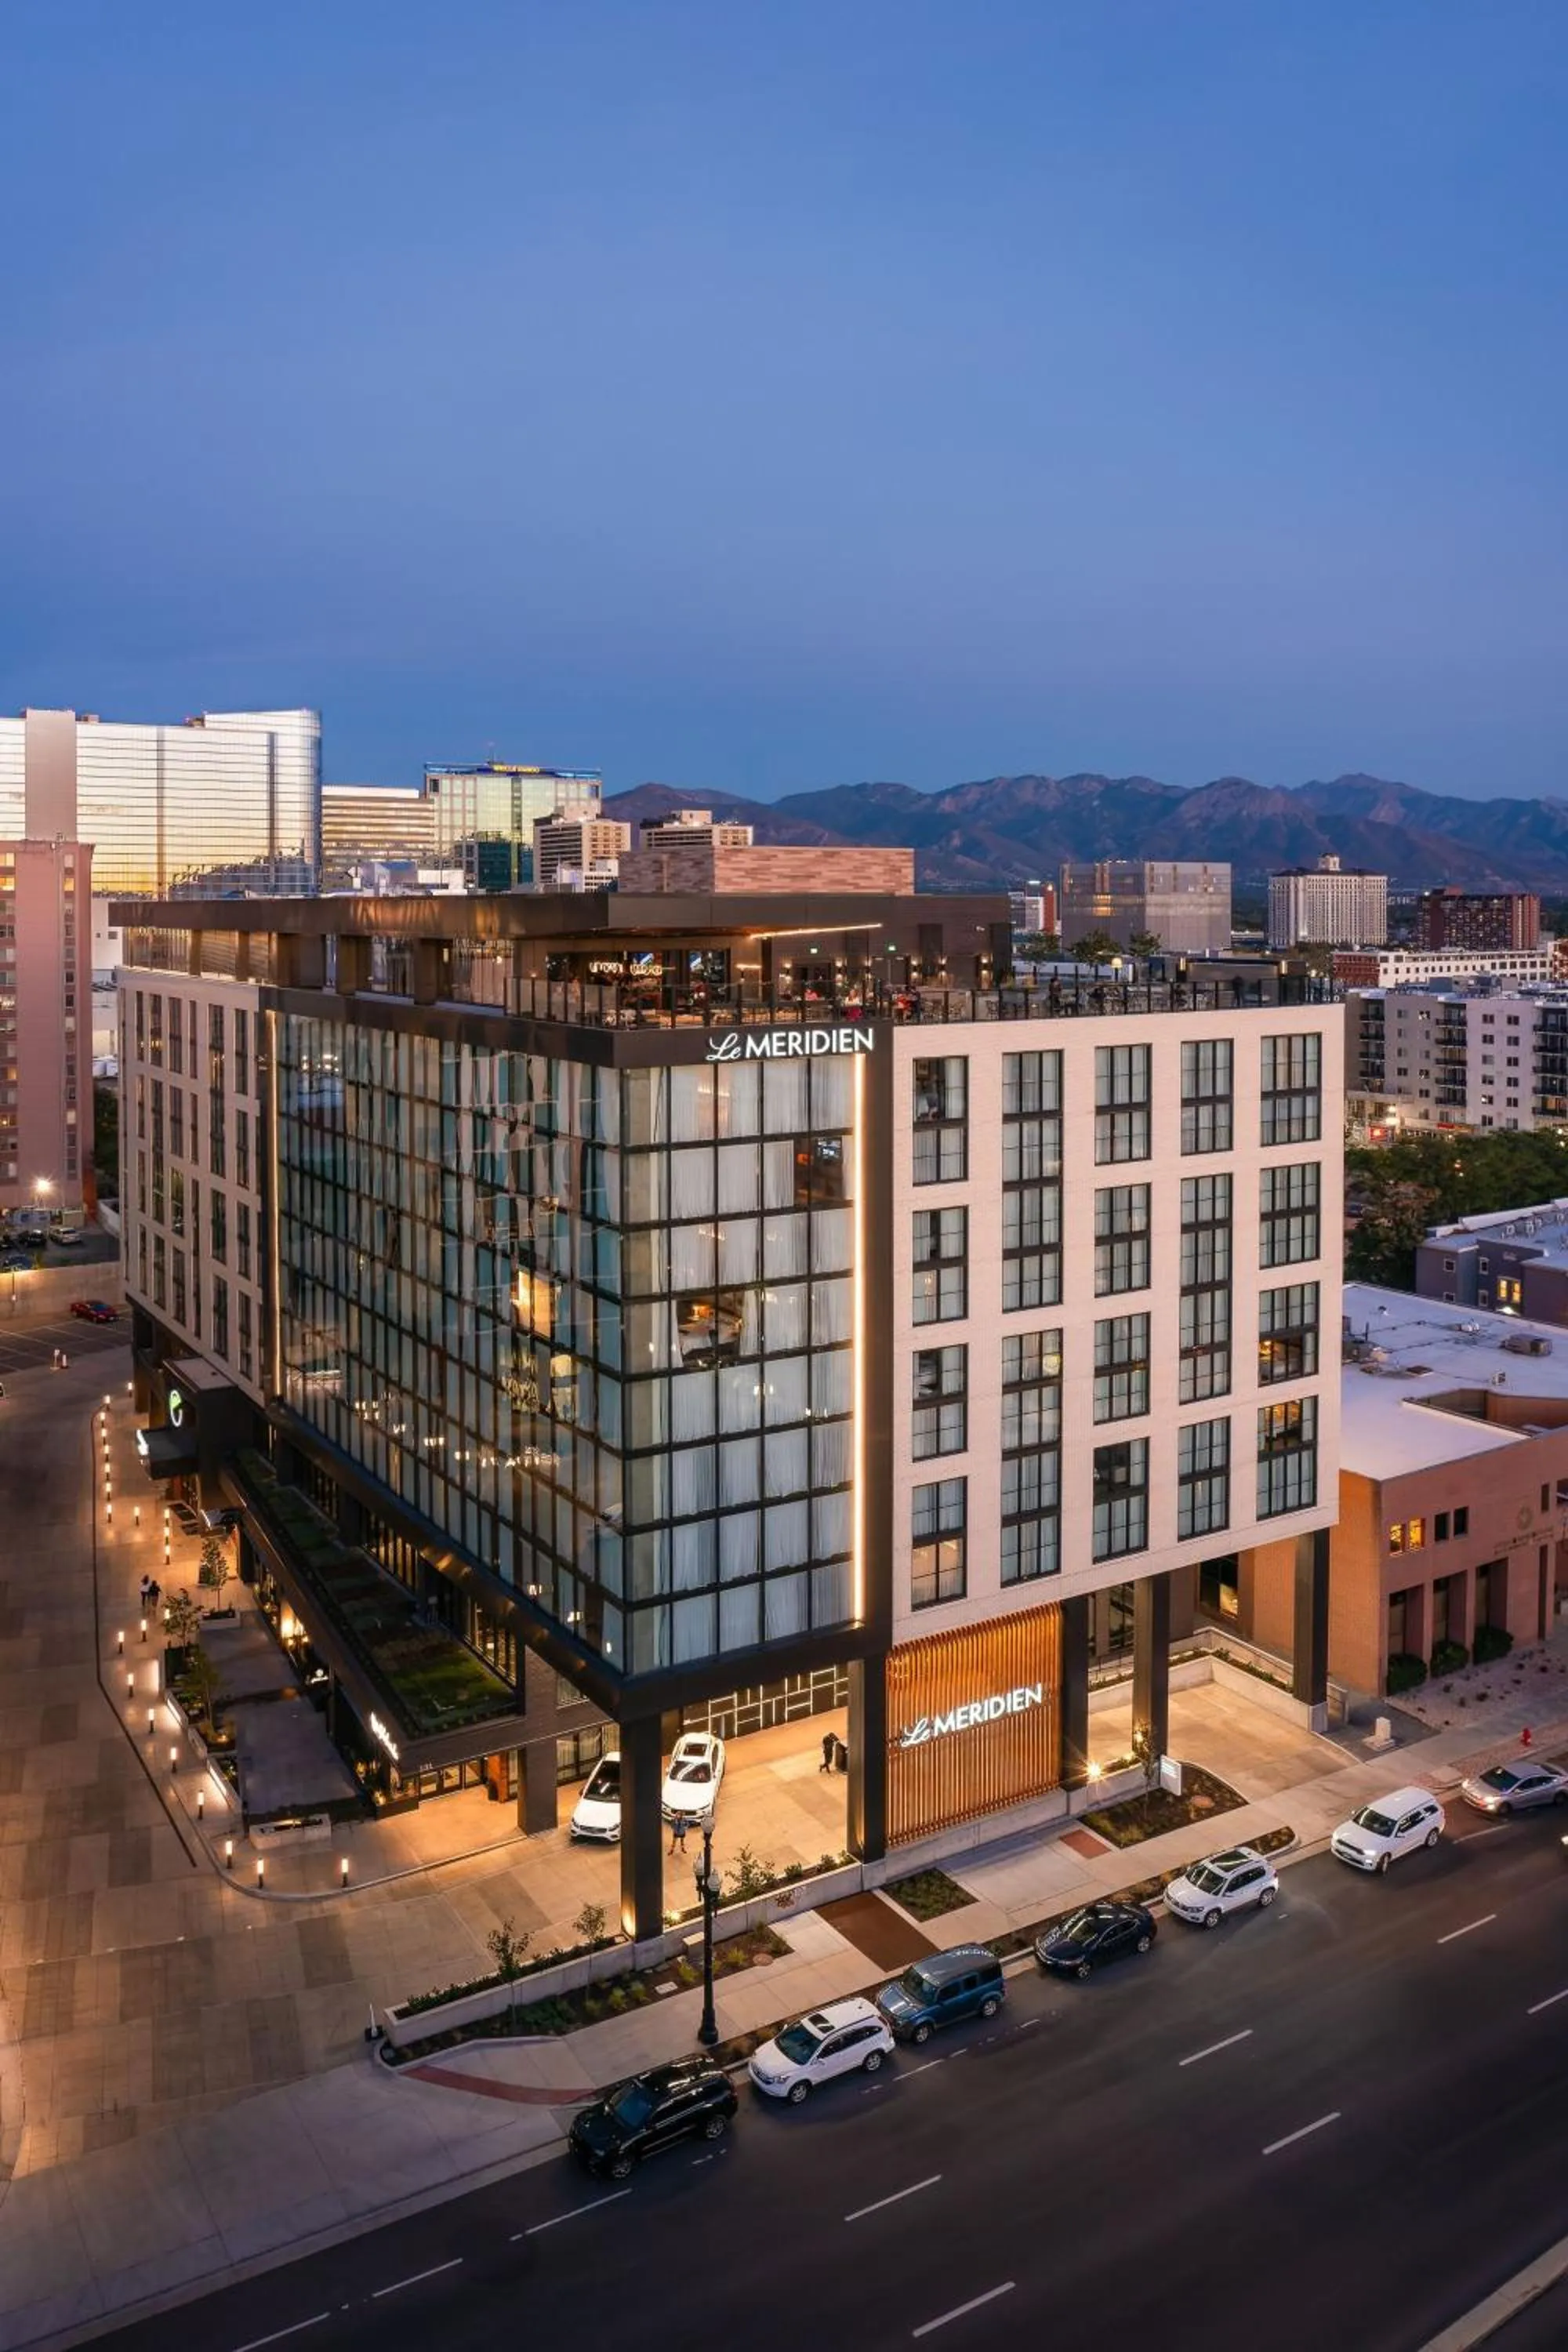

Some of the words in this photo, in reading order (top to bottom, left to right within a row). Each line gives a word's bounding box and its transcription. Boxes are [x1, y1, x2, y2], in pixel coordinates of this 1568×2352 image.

[706, 1033, 742, 1061] Le
[746, 1028, 873, 1058] MERIDIEN
[900, 1718, 931, 1748] Le
[934, 1683, 1042, 1737] MERIDIEN
